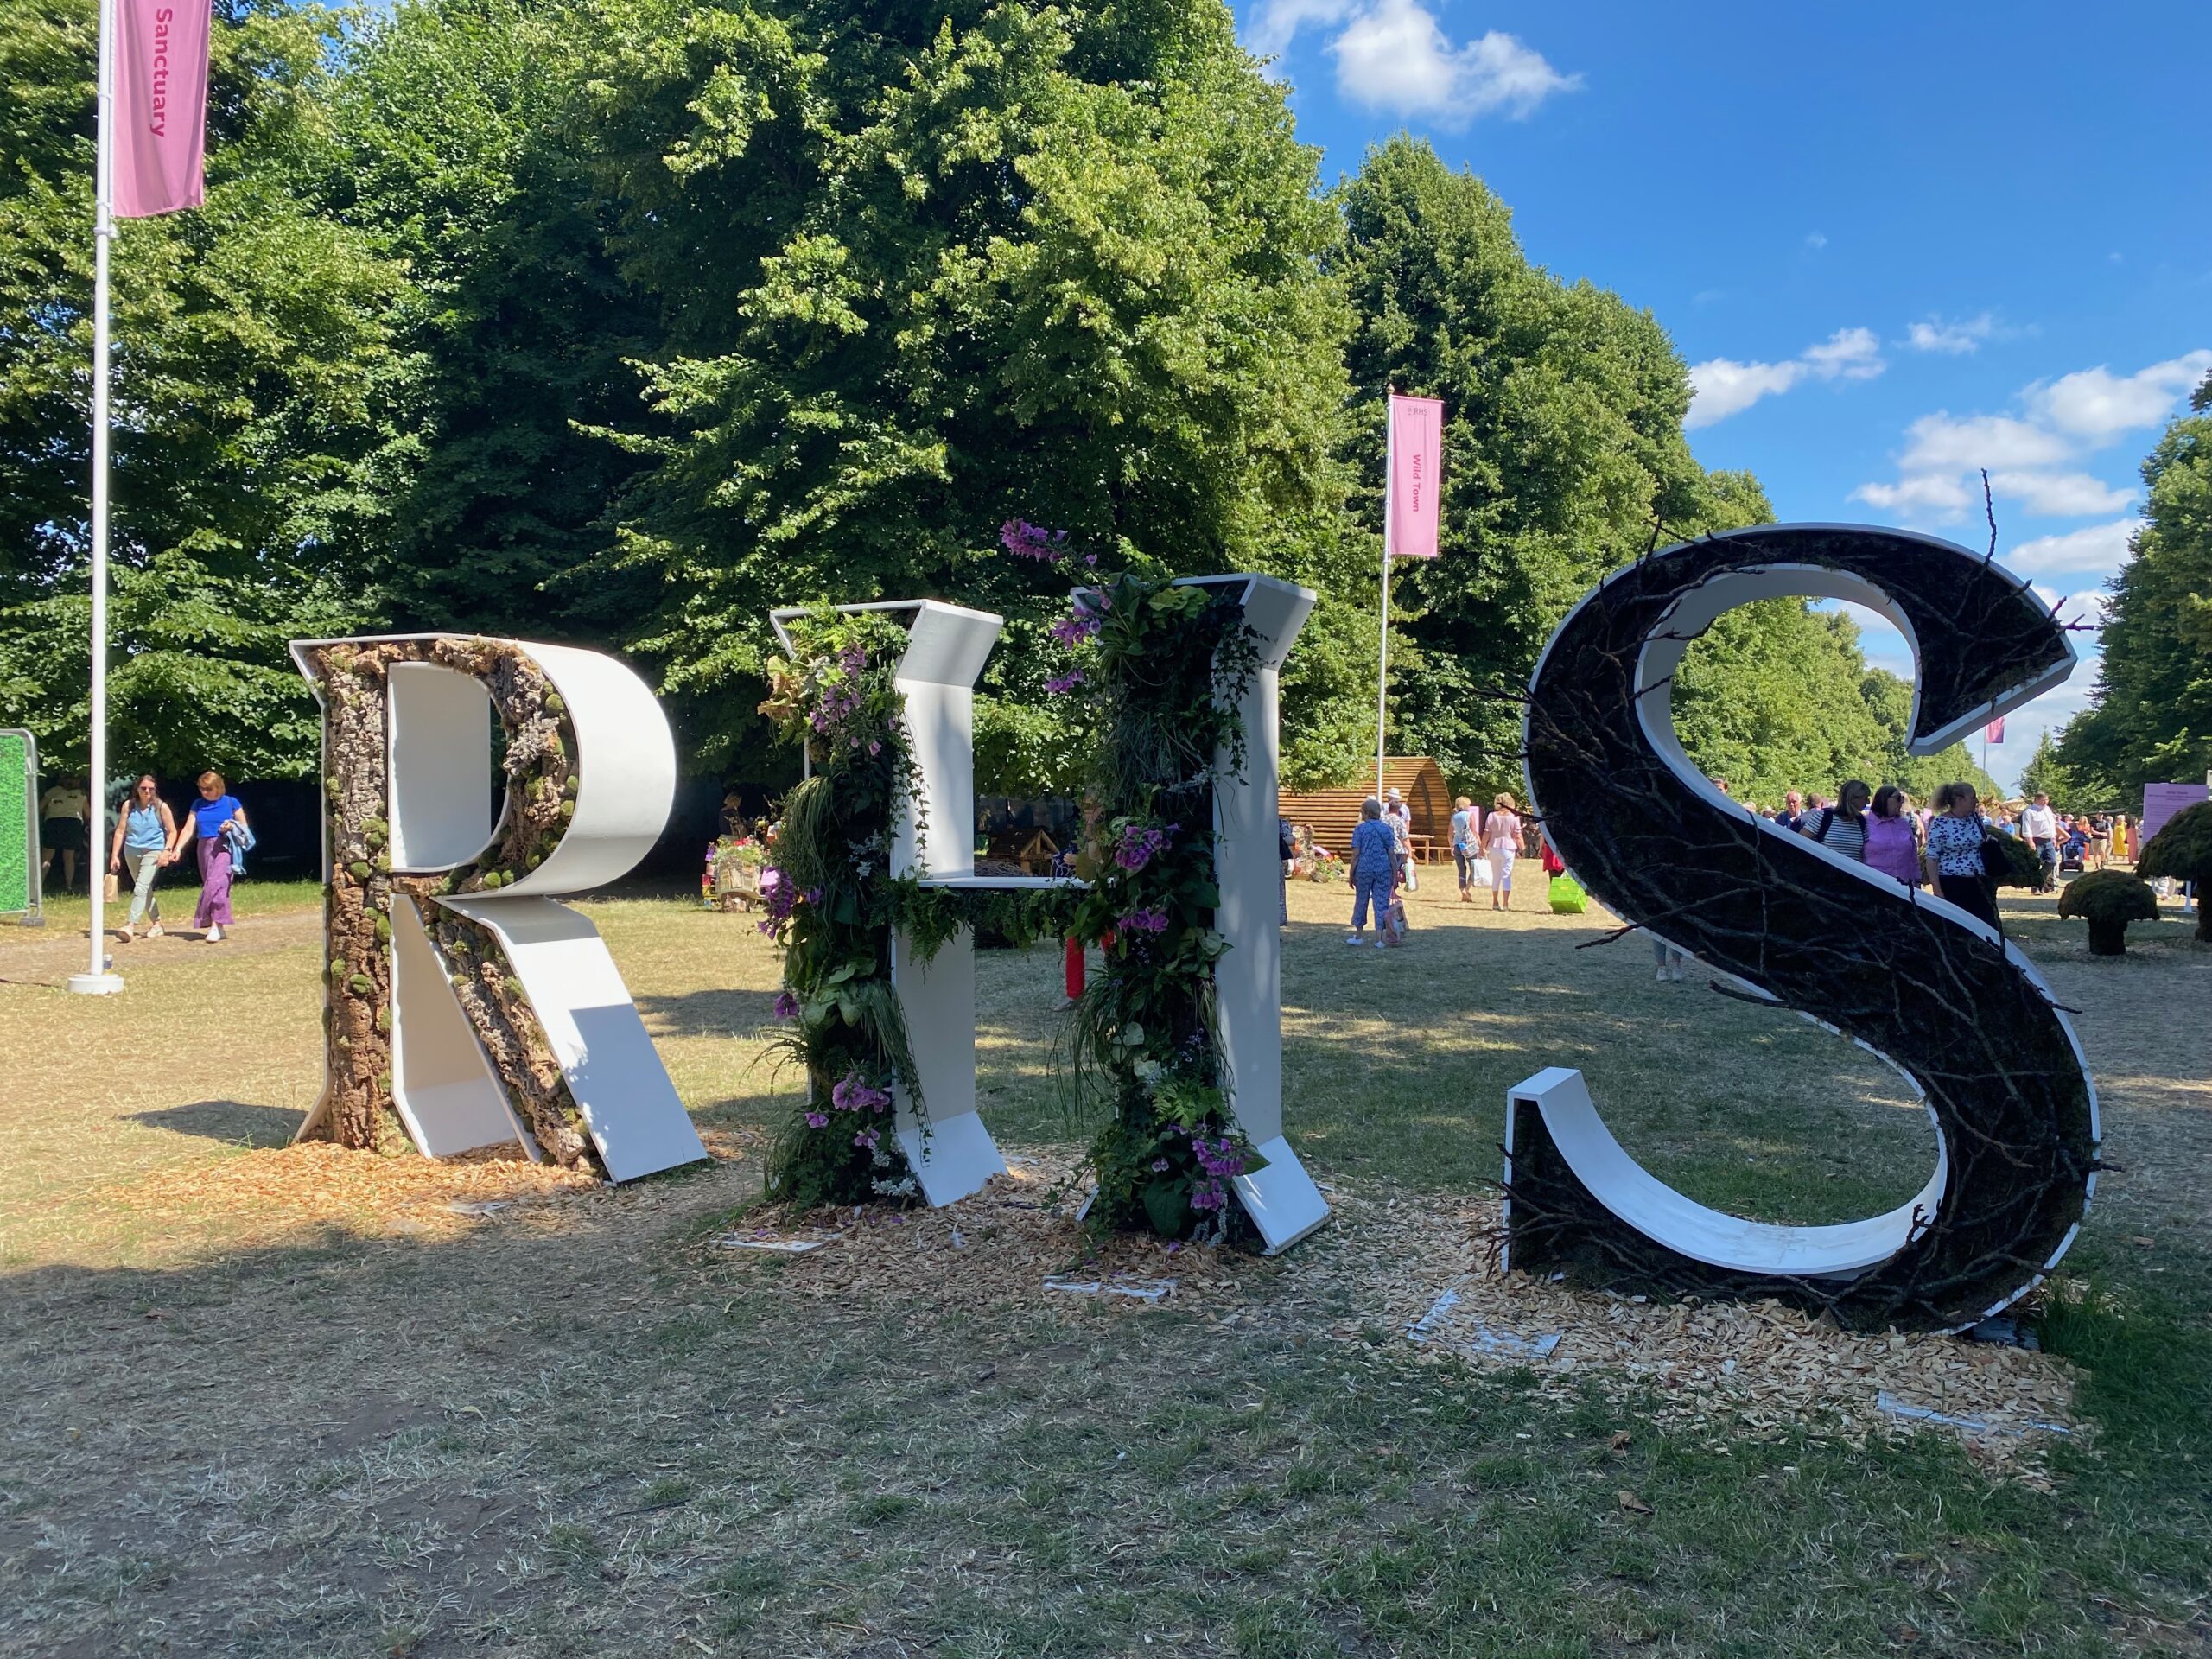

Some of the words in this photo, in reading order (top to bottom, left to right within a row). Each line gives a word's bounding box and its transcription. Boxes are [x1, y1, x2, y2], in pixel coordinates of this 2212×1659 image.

[149, 8, 172, 137] Sanctuary
[1414, 408, 1427, 416] RHS
[1413, 454, 1421, 480] Wild
[289, 523, 2102, 1336] RHS
